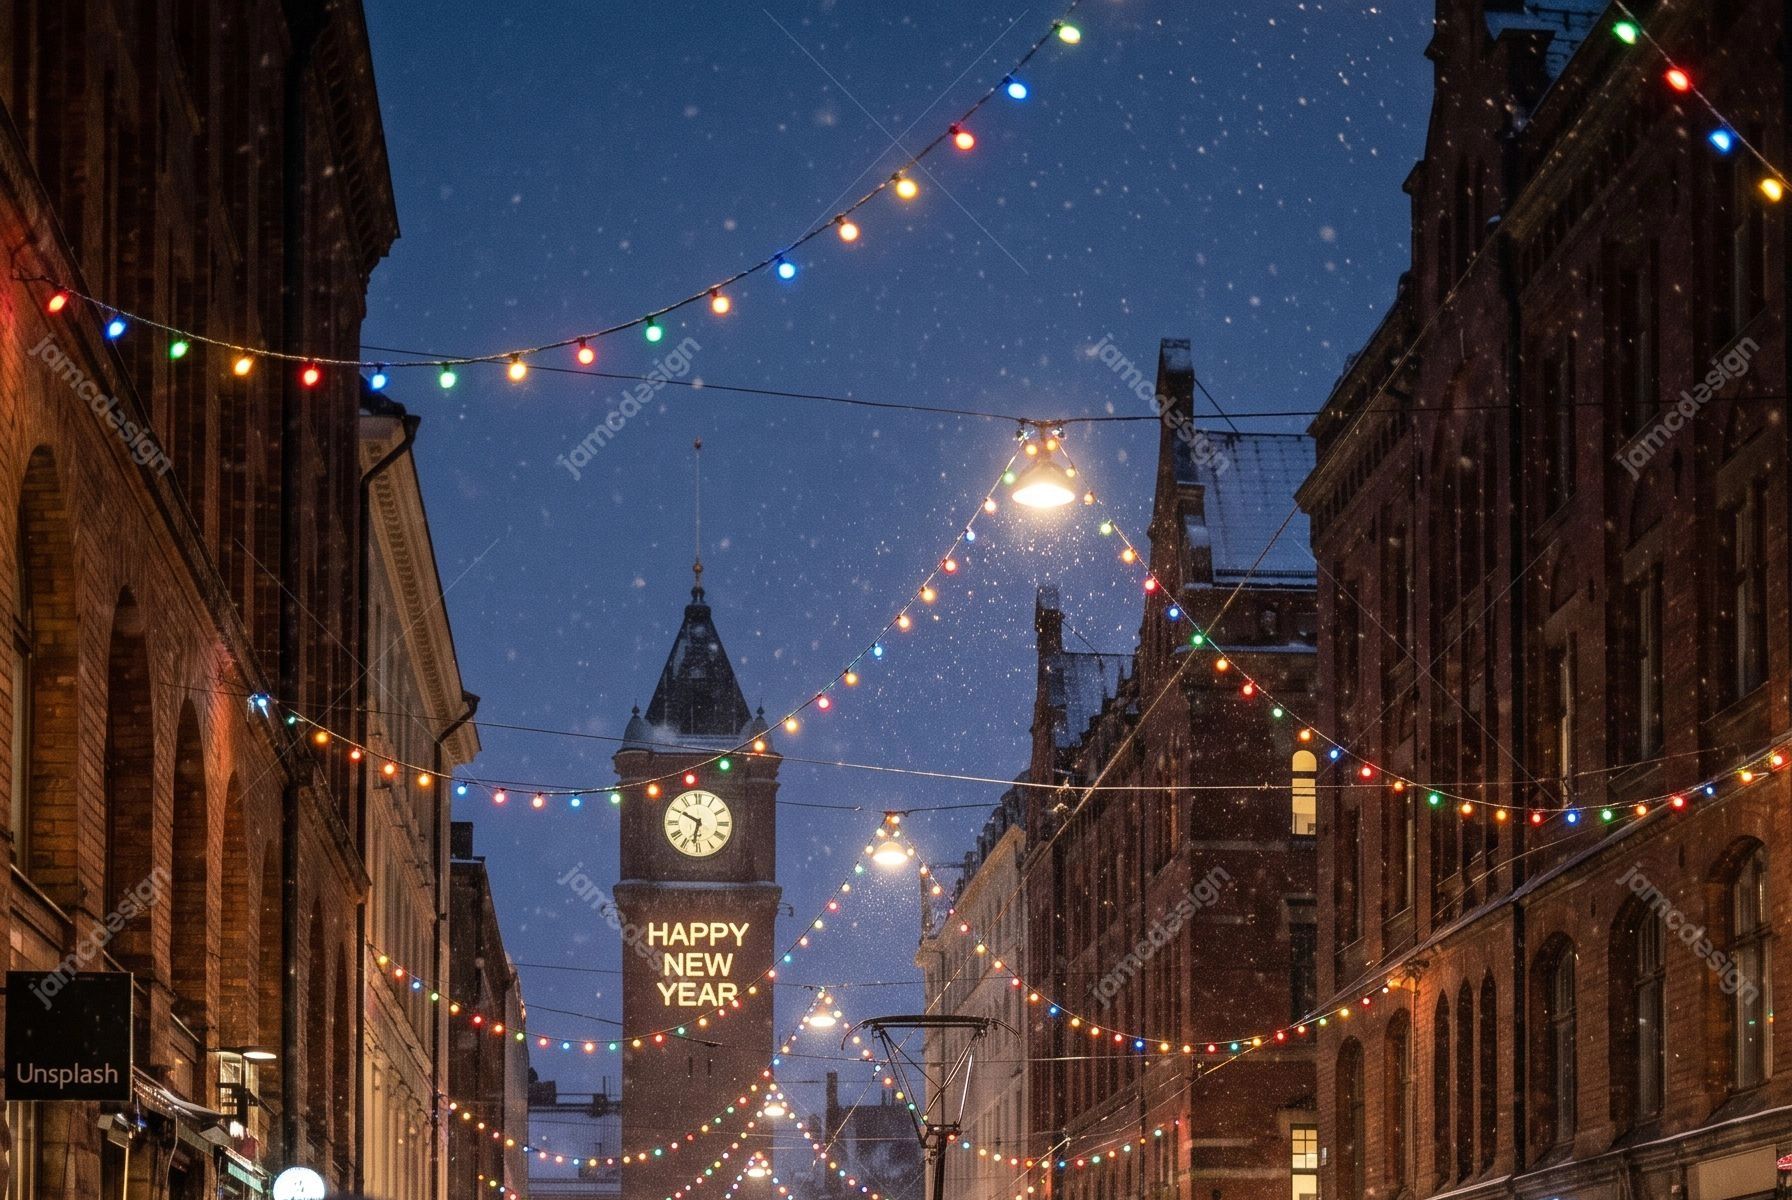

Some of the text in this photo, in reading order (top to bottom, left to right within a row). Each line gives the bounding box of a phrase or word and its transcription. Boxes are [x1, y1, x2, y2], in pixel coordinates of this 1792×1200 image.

[648, 922, 750, 946] HAPPY
[663, 953, 734, 976] NEW
[657, 982, 738, 1007] YEAR
[16, 1062, 119, 1090] Unsplash
